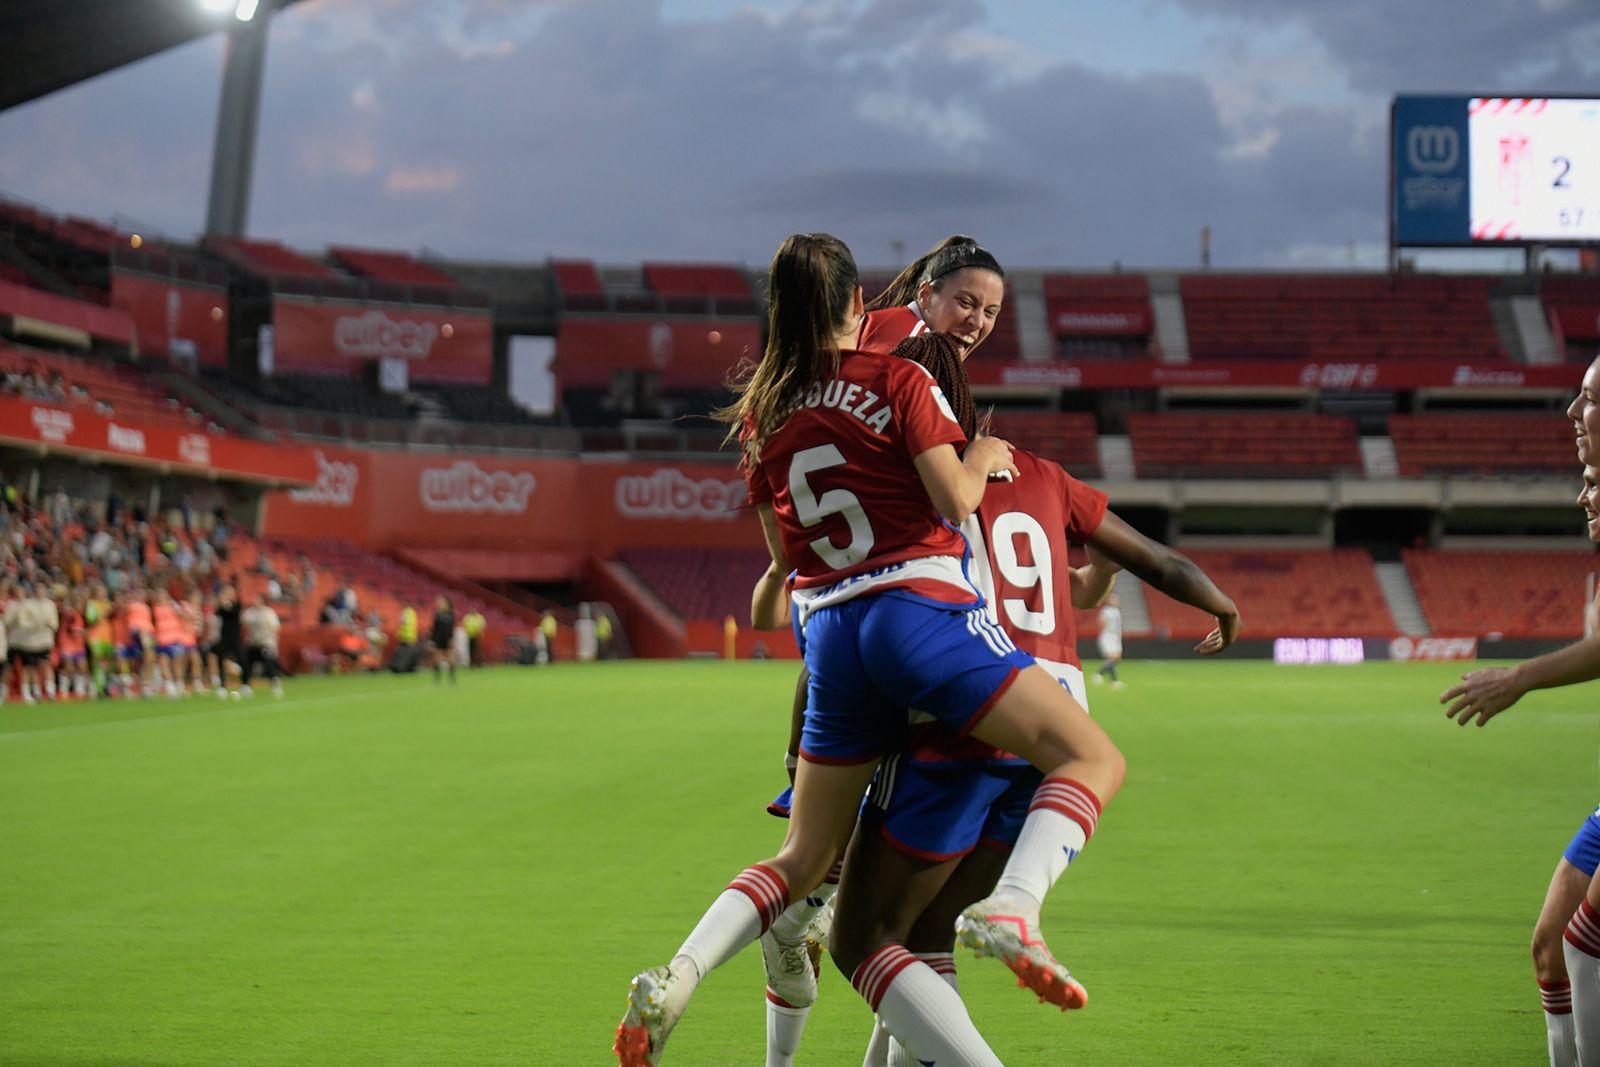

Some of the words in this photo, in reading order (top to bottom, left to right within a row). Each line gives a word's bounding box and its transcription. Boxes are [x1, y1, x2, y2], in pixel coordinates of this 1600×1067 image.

[1552, 155, 1572, 188] 2
[420, 460, 537, 513] wiber
[788, 443, 876, 571] 5
